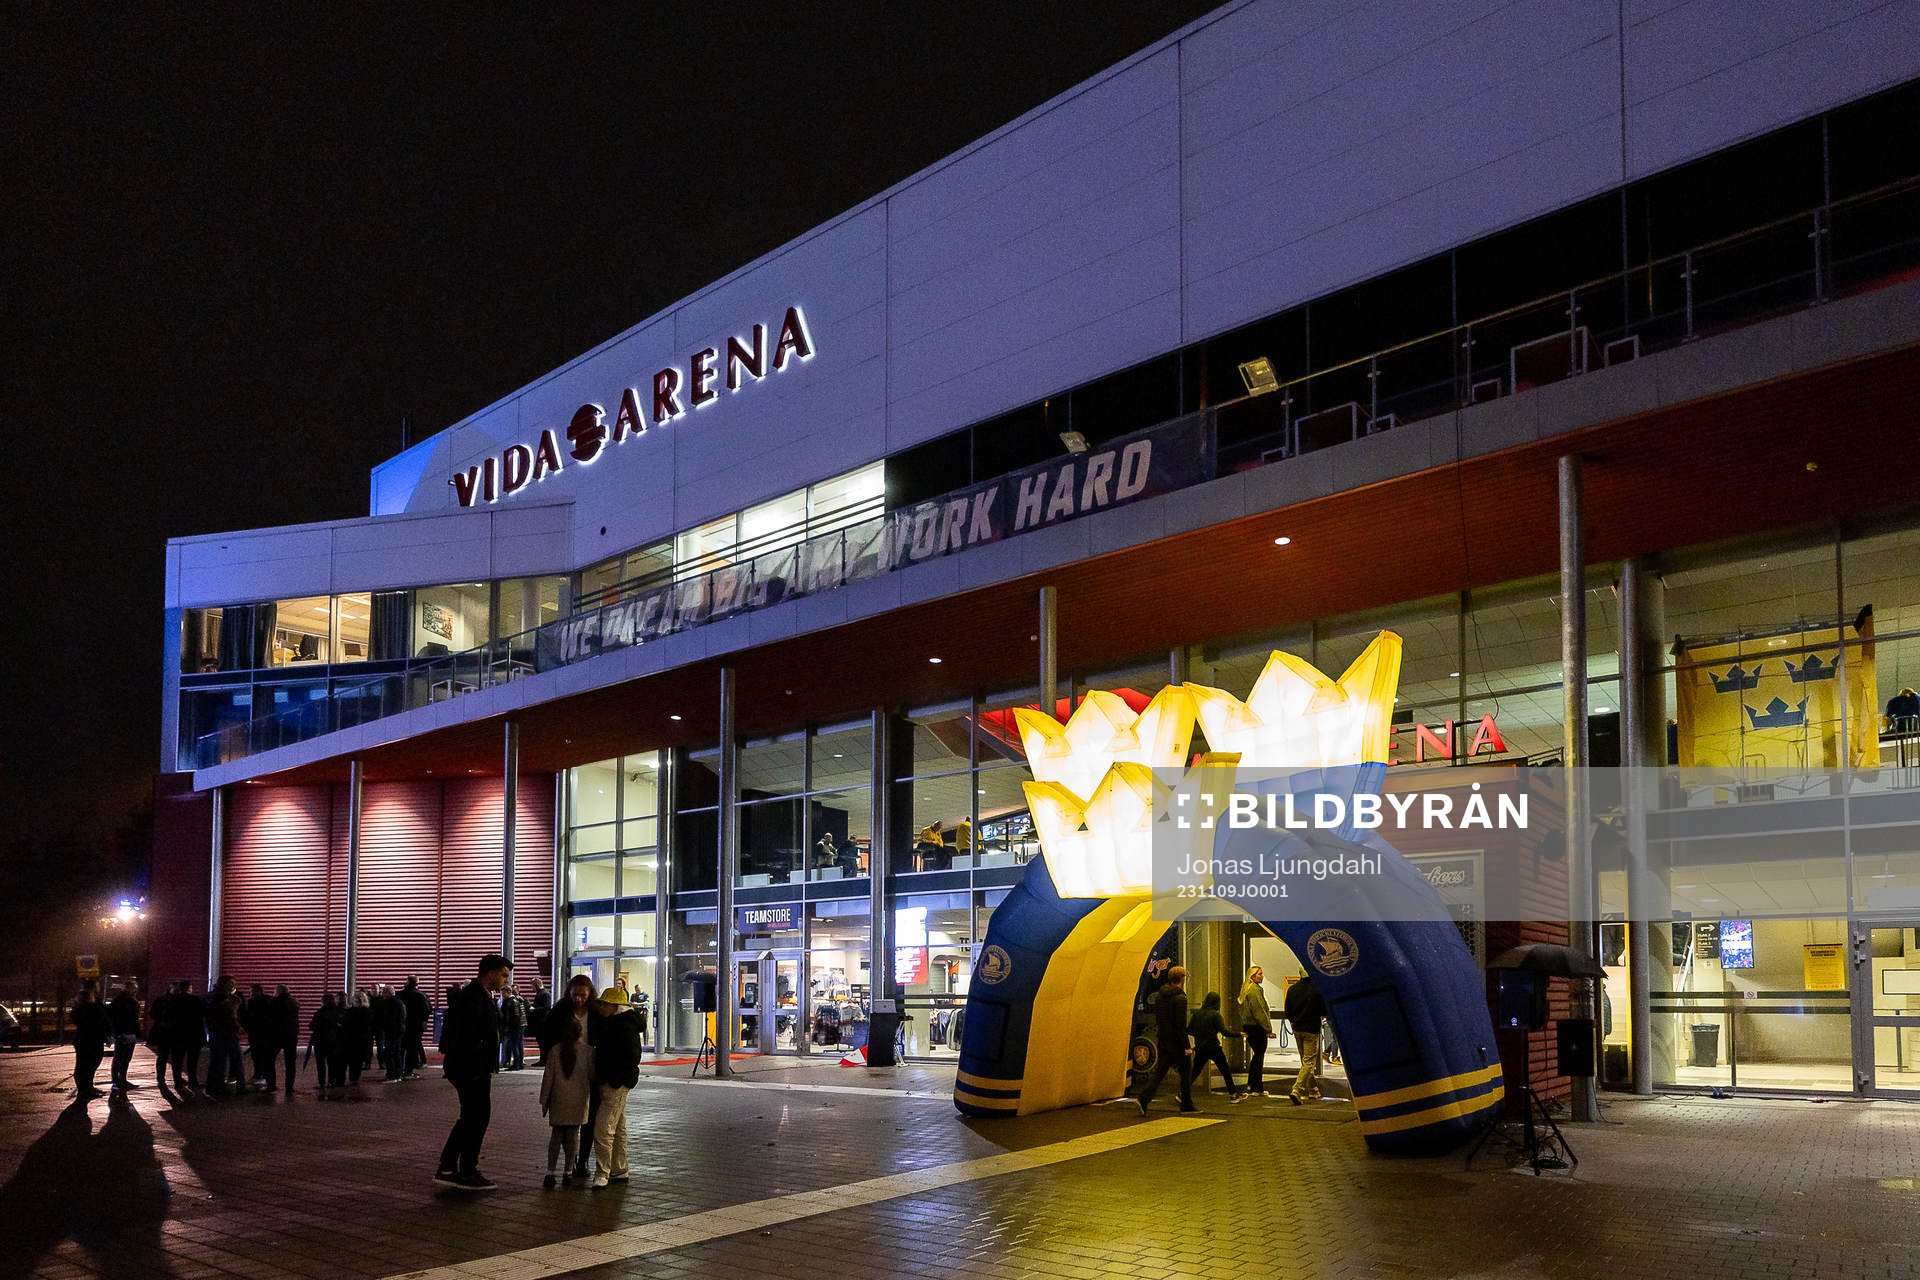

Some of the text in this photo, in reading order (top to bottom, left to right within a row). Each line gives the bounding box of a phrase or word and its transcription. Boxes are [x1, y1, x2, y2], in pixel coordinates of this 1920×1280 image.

[455, 306, 816, 506] VIDA ARENA
[560, 614, 598, 662] WE
[1014, 439, 1152, 531] HARD
[745, 908, 791, 924] TEAMSTORE
